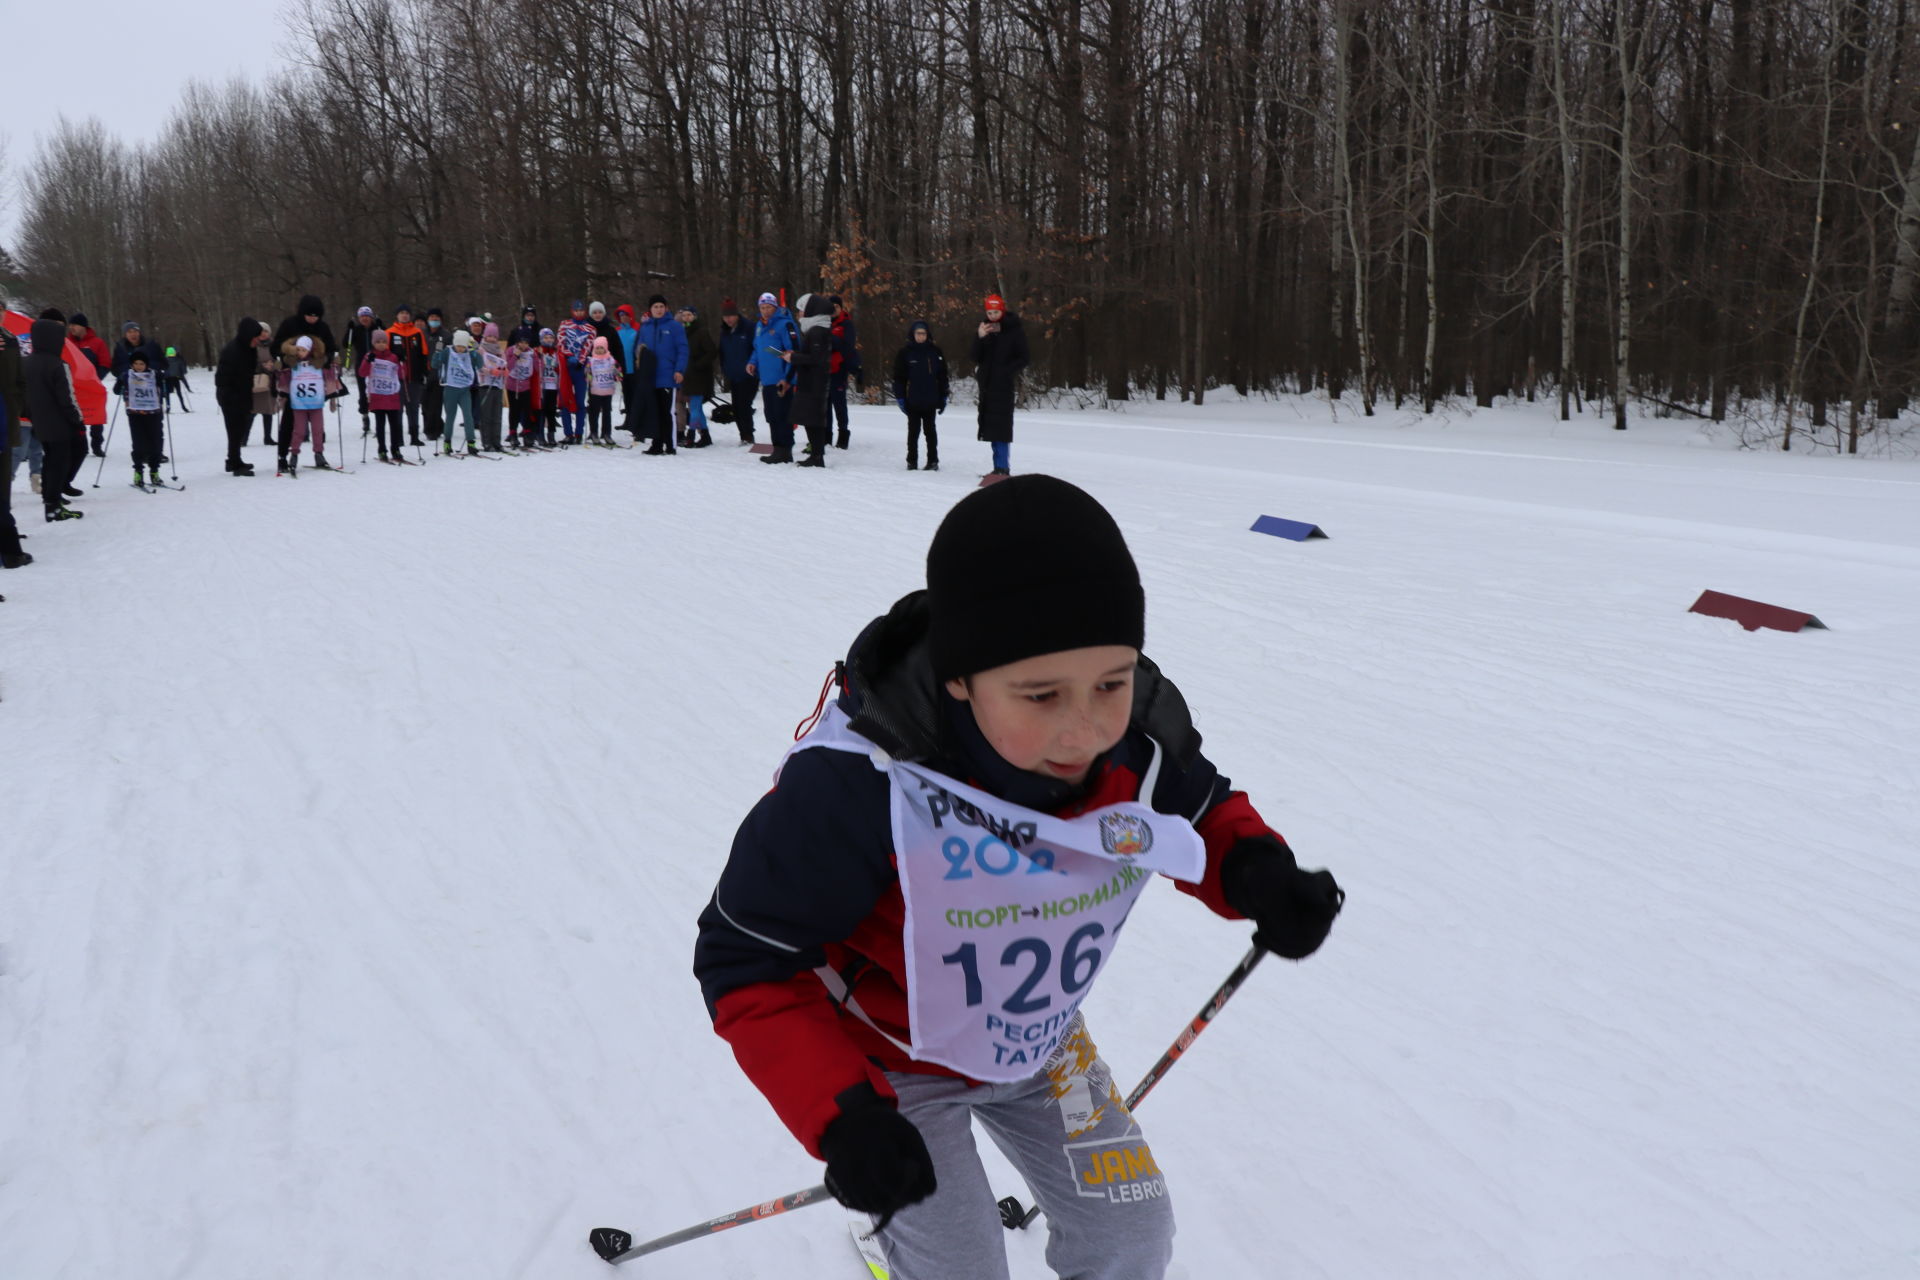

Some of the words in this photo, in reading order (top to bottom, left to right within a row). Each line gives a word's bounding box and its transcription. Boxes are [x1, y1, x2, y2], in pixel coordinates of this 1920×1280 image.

[296, 383, 317, 398] 85
[941, 835, 1068, 880] 202
[944, 903, 1021, 929] СПОРТ
[942, 898, 1127, 1016] 126
